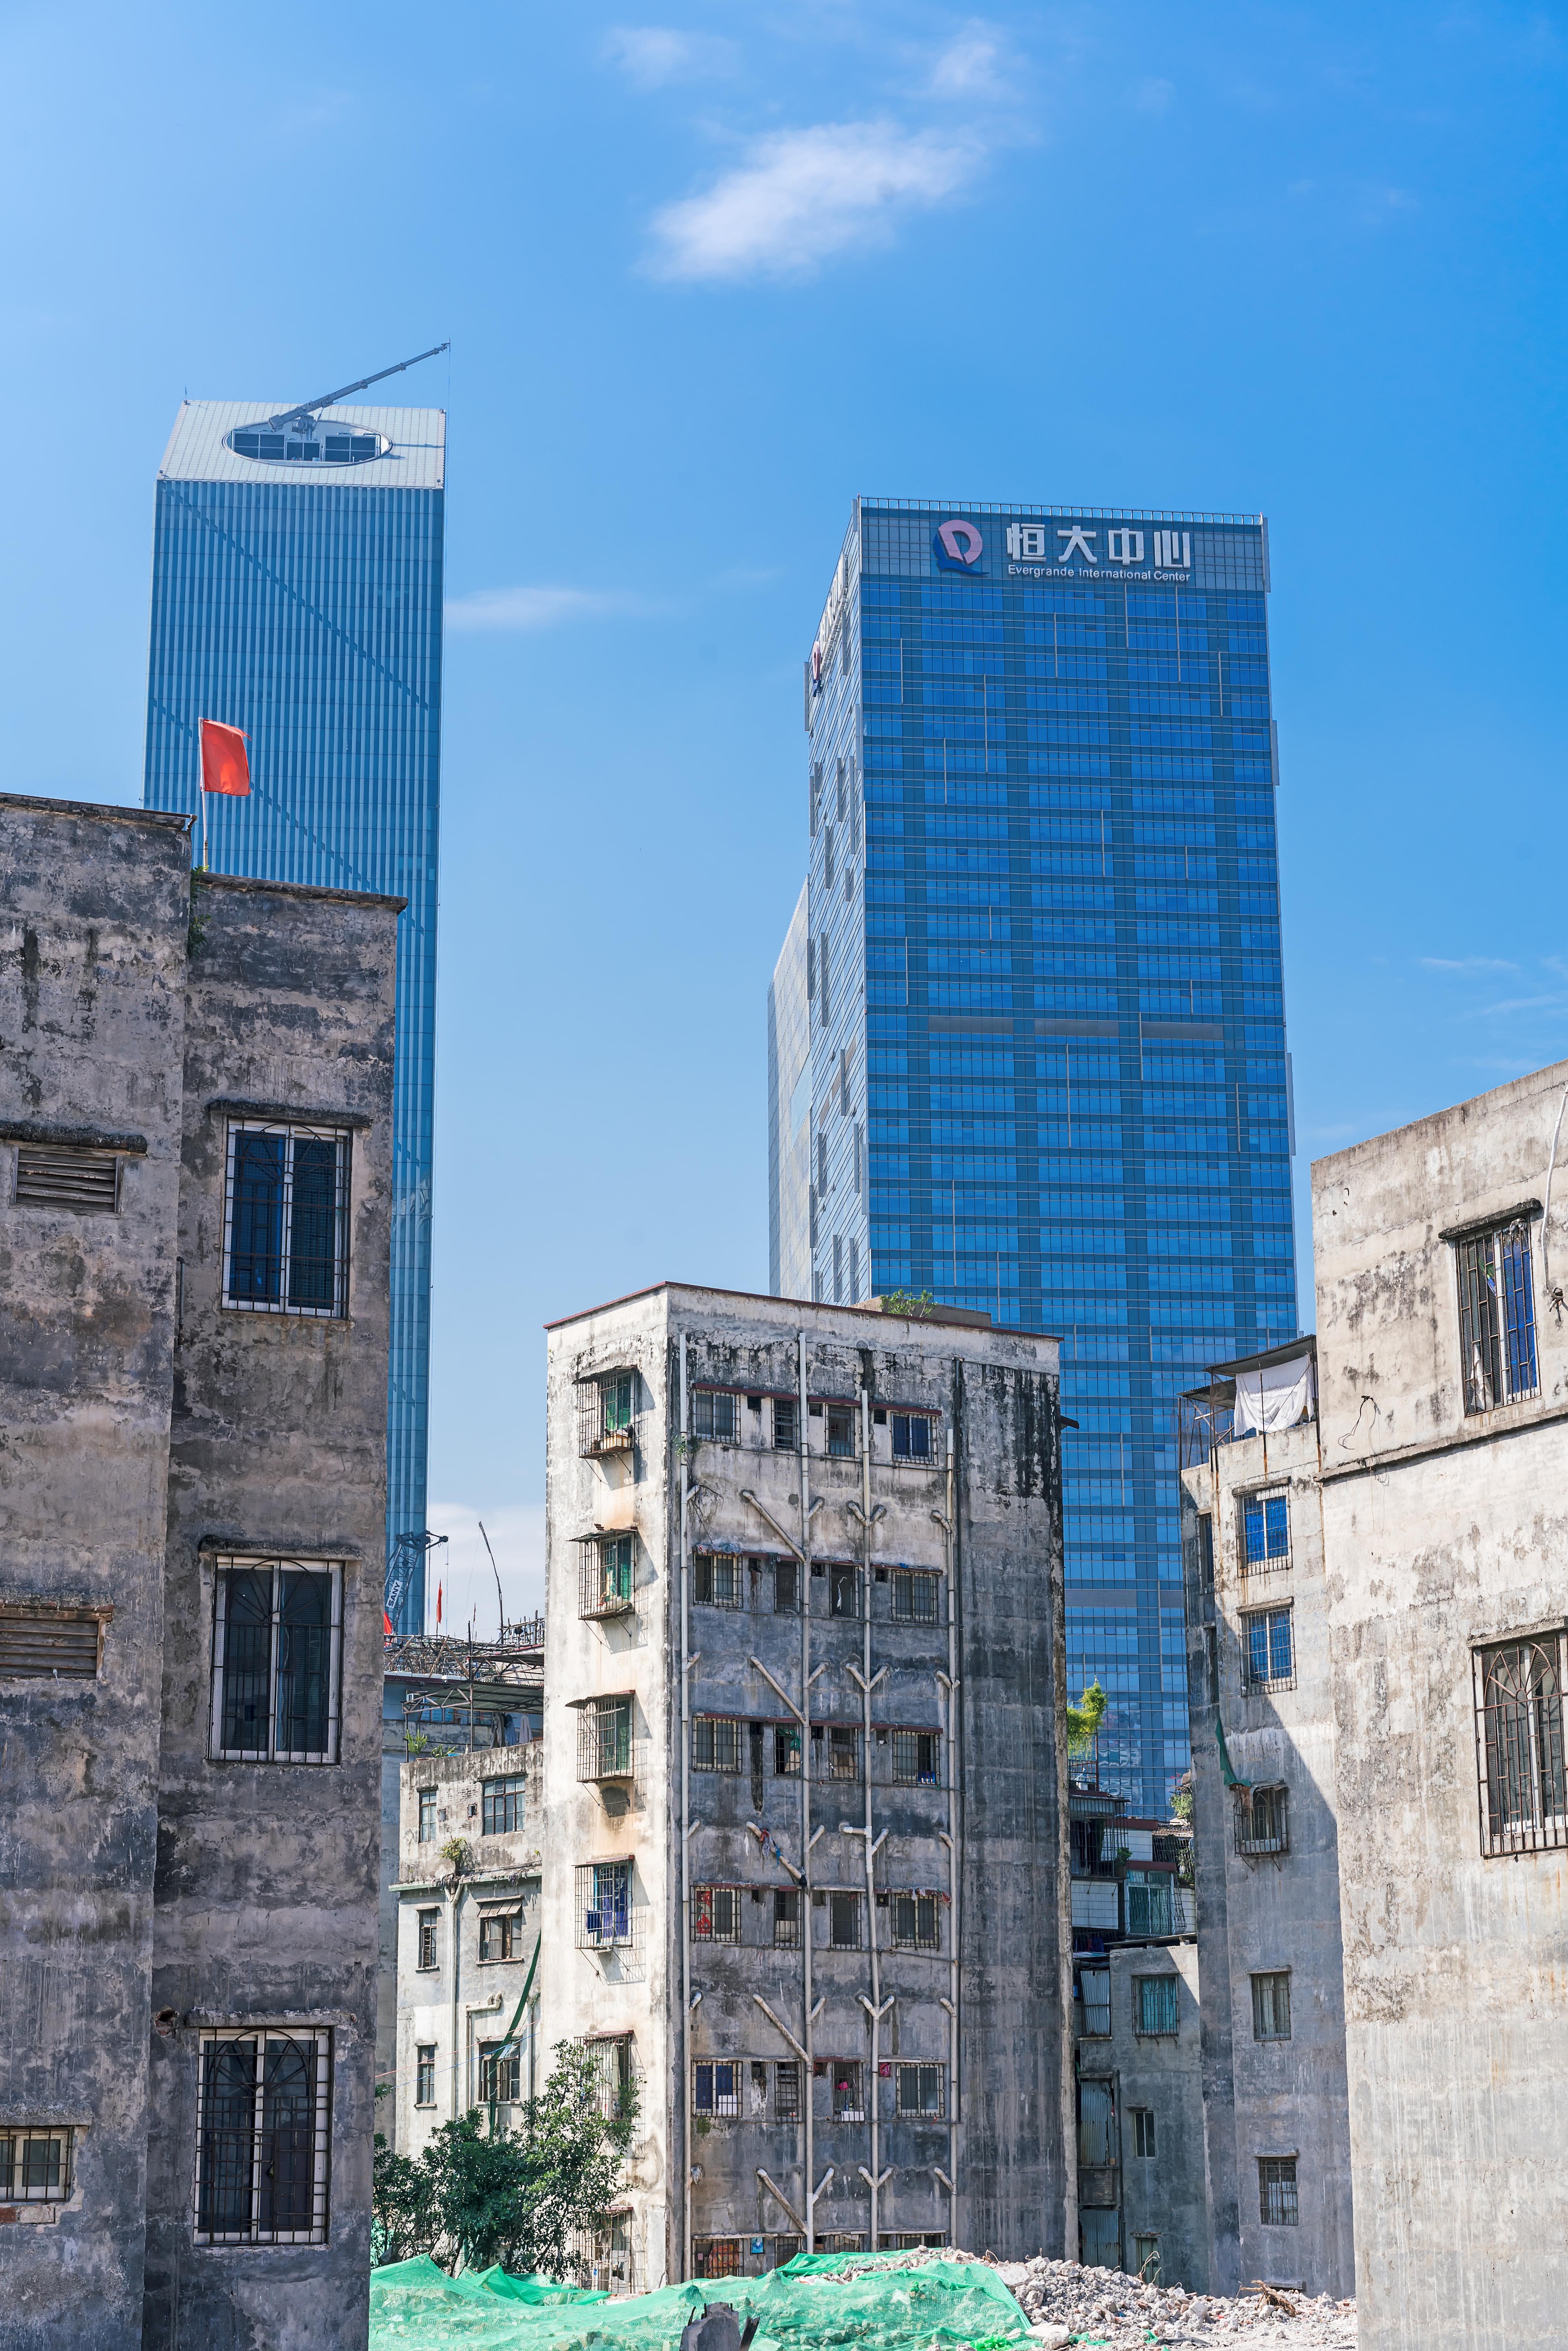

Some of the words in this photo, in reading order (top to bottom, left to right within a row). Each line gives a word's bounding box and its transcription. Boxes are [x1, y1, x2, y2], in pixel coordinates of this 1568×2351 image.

[1007, 523, 1191, 568] 恒大中心
[1008, 564, 1074, 578] Evergrande
[1079, 568, 1151, 581] International
[1154, 570, 1191, 582] Center
[388, 1582, 400, 1607] SANY
